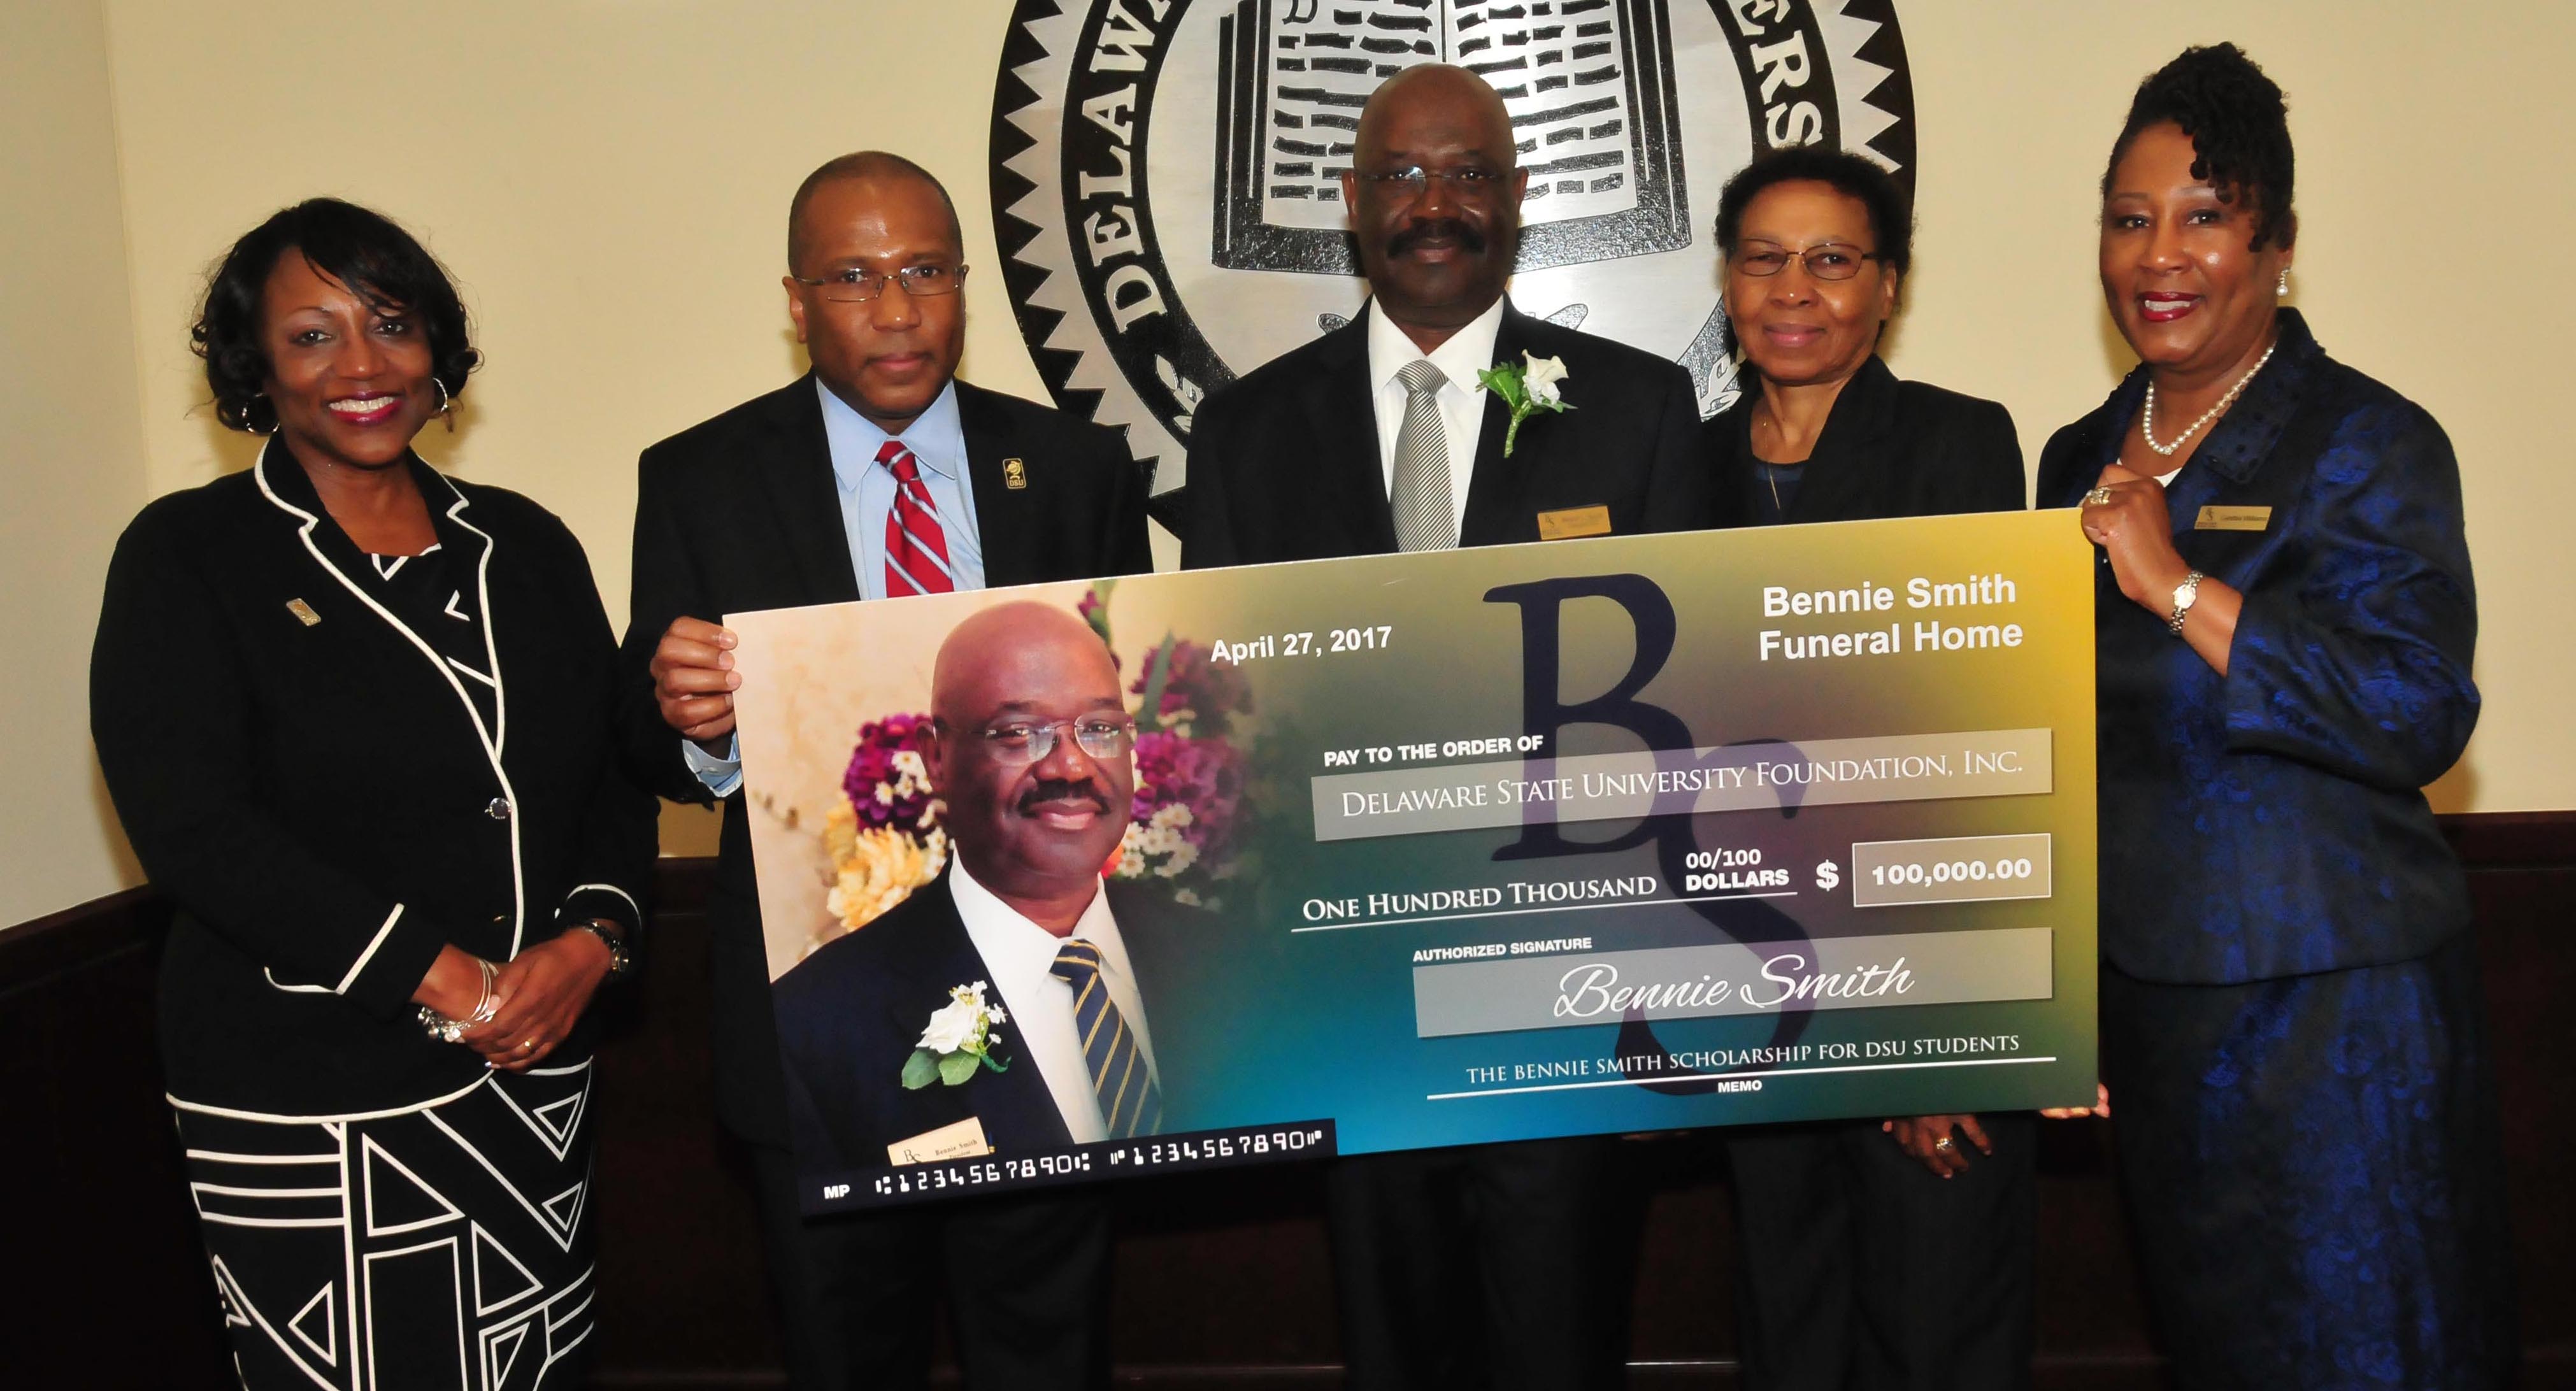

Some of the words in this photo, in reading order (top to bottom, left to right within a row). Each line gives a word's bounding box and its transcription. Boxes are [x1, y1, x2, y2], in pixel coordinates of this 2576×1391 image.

[1080, 0, 1171, 333] DELAW
[1763, 581, 1894, 617] Bennie
[1906, 573, 2017, 609] Smith
[1210, 635, 1274, 666] April
[1282, 632, 1322, 658] 27,
[1329, 625, 1392, 653] 2017
[1759, 623, 1901, 661] Funeral
[1914, 619, 2024, 652] Home
[1324, 750, 1360, 767] PAY
[1364, 746, 1392, 763] TO
[1397, 743, 1438, 761] THE
[1442, 738, 1512, 758] ORDER
[1516, 735, 1543, 752] OF
[1342, 784, 1488, 817] DELAWARE
[1497, 776, 1574, 804] STATE
[1582, 766, 1747, 798] UNIVERSITY
[1755, 753, 1954, 787] FOUNDATION,
[1963, 750, 2023, 774] INC.
[1685, 847, 1762, 870] 00/100
[1685, 868, 1790, 891] DOLLARS
[1815, 859, 1840, 892] $
[1871, 857, 2032, 887] 100,000.00
[1302, 897, 1361, 922] ONE
[1368, 887, 1502, 917] HUNDRED
[1506, 874, 1657, 904] THOUSAND
[1412, 943, 1507, 962] AUTHORIZED
[1510, 937, 1592, 954] SIGNATURE
[1553, 963, 1733, 1018] Bennie
[1739, 953, 1915, 1009] Smith
[1466, 1066, 1507, 1084] THE
[1514, 1060, 1589, 1080] BENNIE
[1596, 1055, 1662, 1074] SMITH
[1669, 1045, 1812, 1069] SCHOLARSHIP
[1818, 1043, 1860, 1060] FOR
[1865, 1040, 1907, 1058] DSU
[1913, 1034, 2020, 1055] STUDENTS
[1717, 1079, 1763, 1094] MEMO
[934, 1146, 956, 1157] Bennie
[958, 1139, 978, 1150] Smith
[823, 1184, 851, 1199] MP
